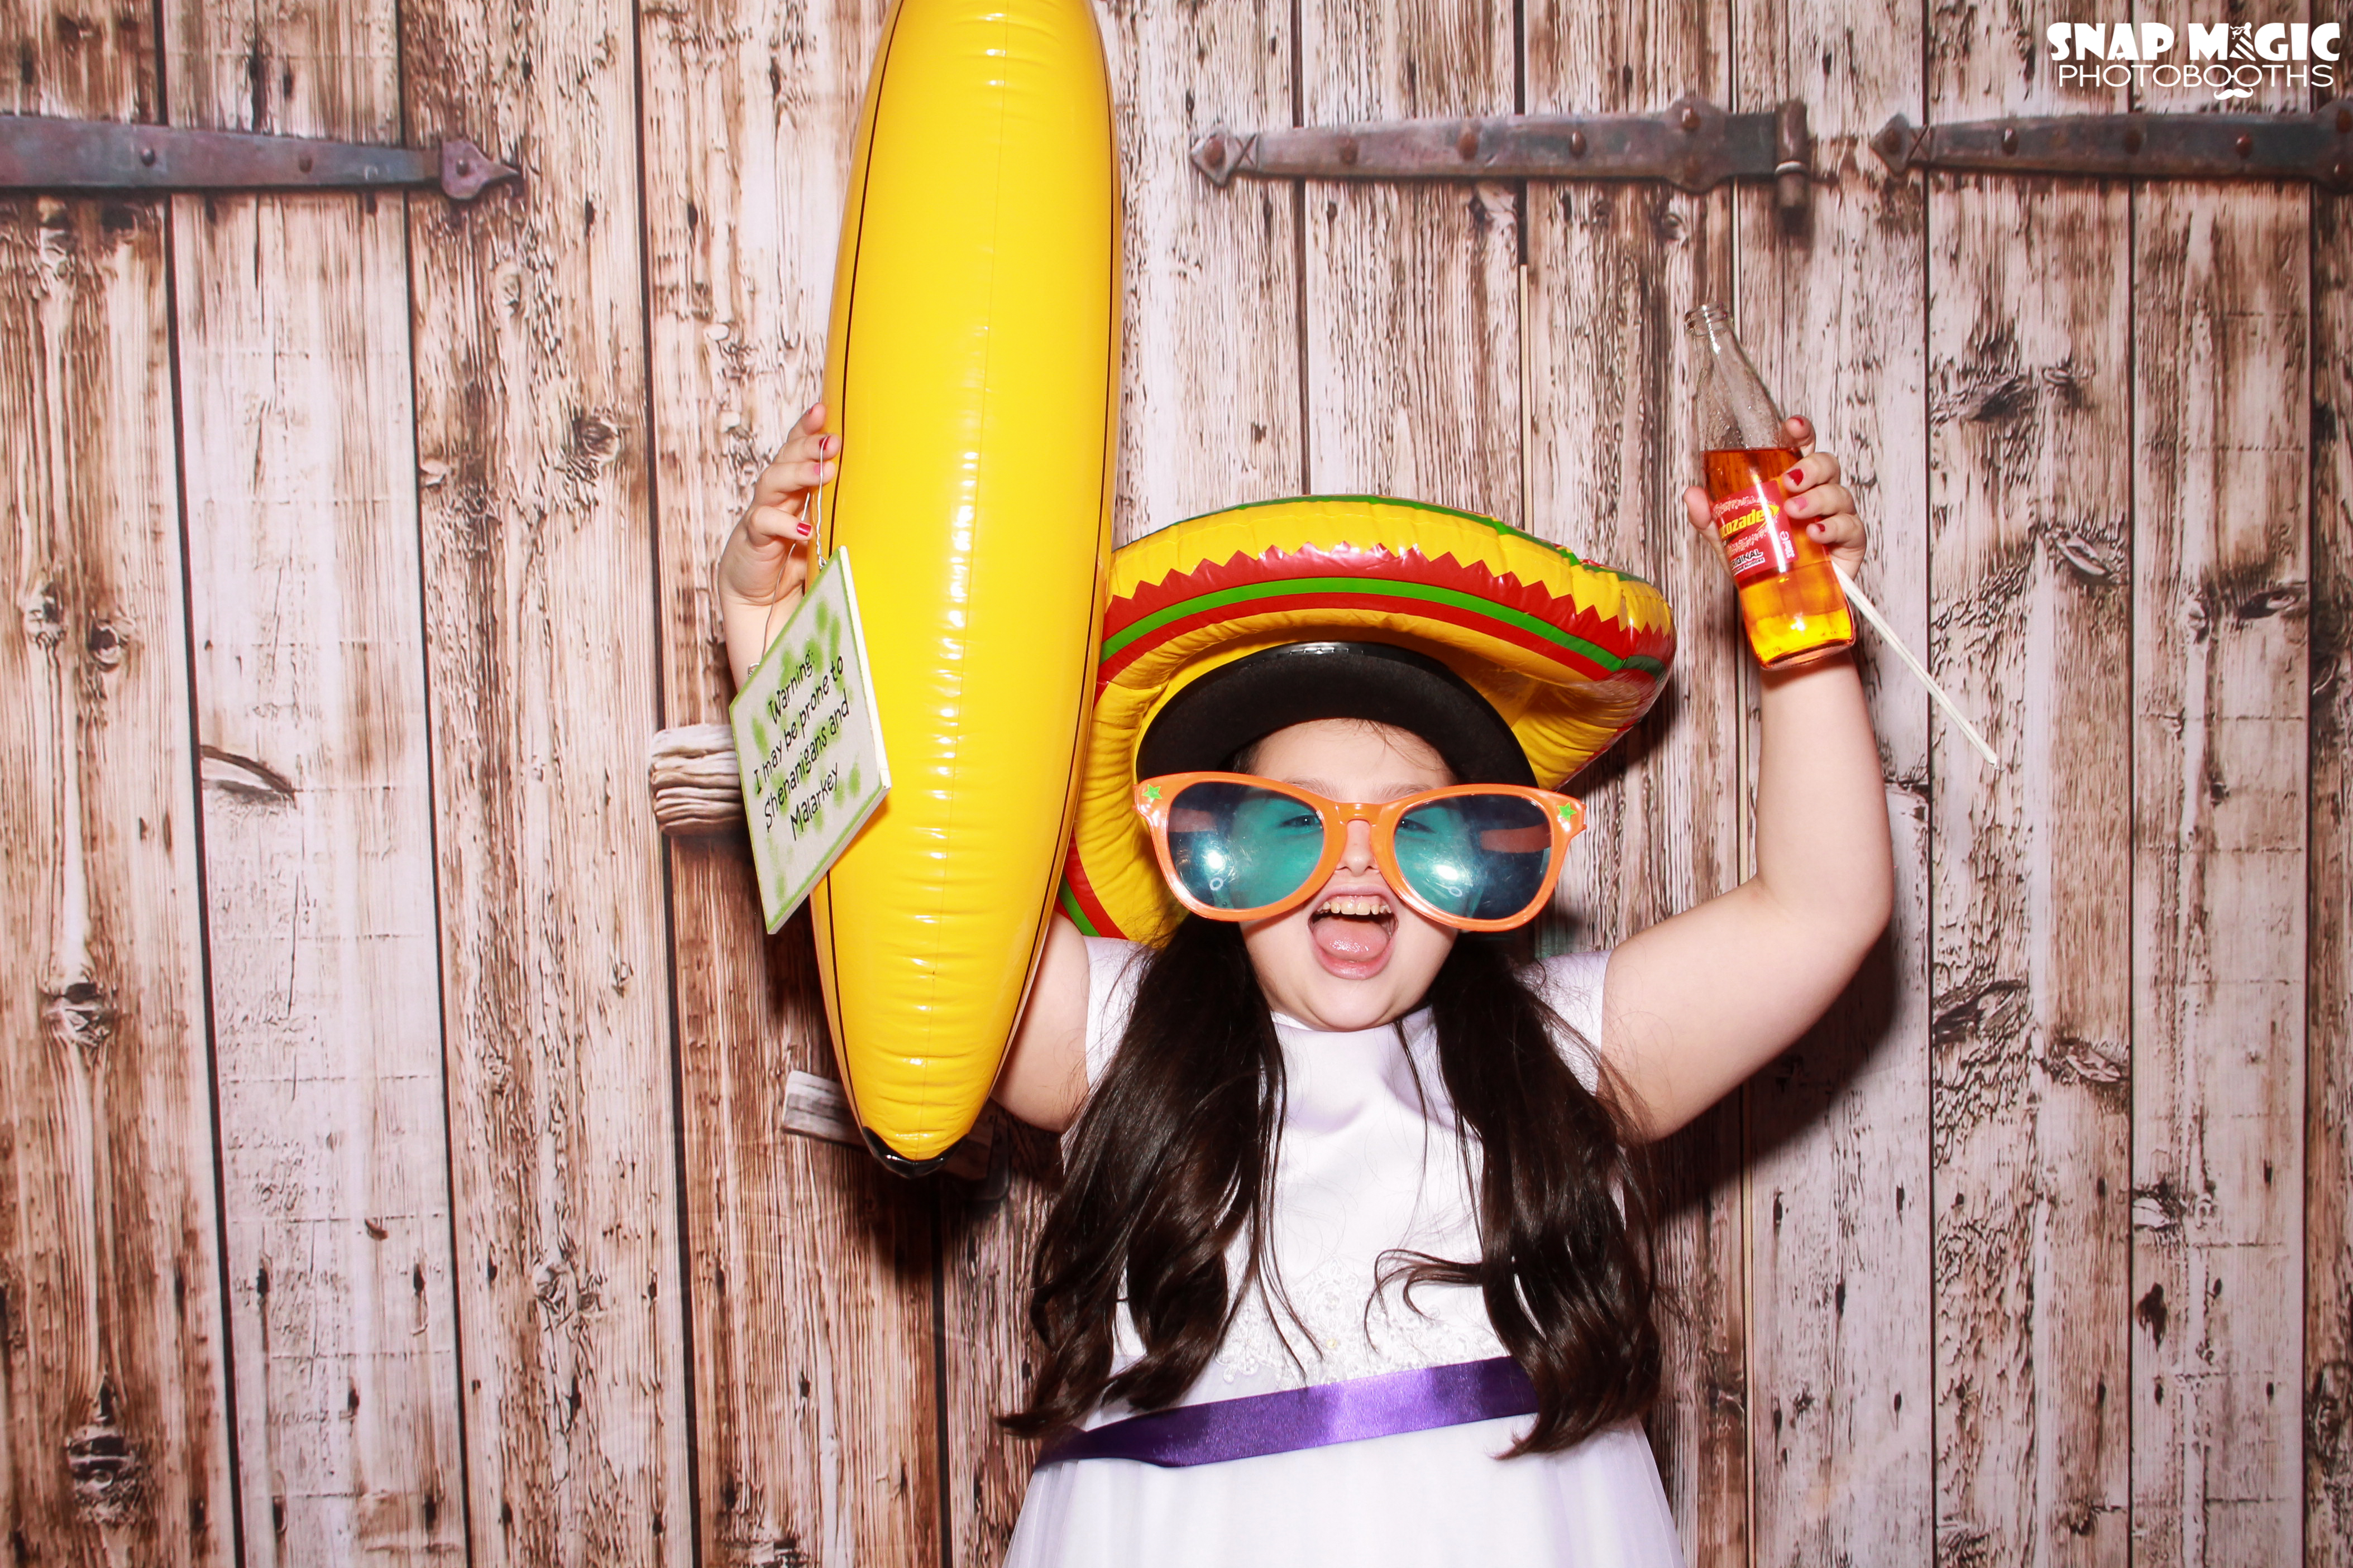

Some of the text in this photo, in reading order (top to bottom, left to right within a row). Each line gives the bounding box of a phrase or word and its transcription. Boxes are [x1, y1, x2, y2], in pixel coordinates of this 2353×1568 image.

[754, 655, 844, 795] I may be prone to
[768, 649, 815, 725] Warning:
[764, 688, 849, 833] Shenanigans and
[790, 762, 838, 841] Malarkey
